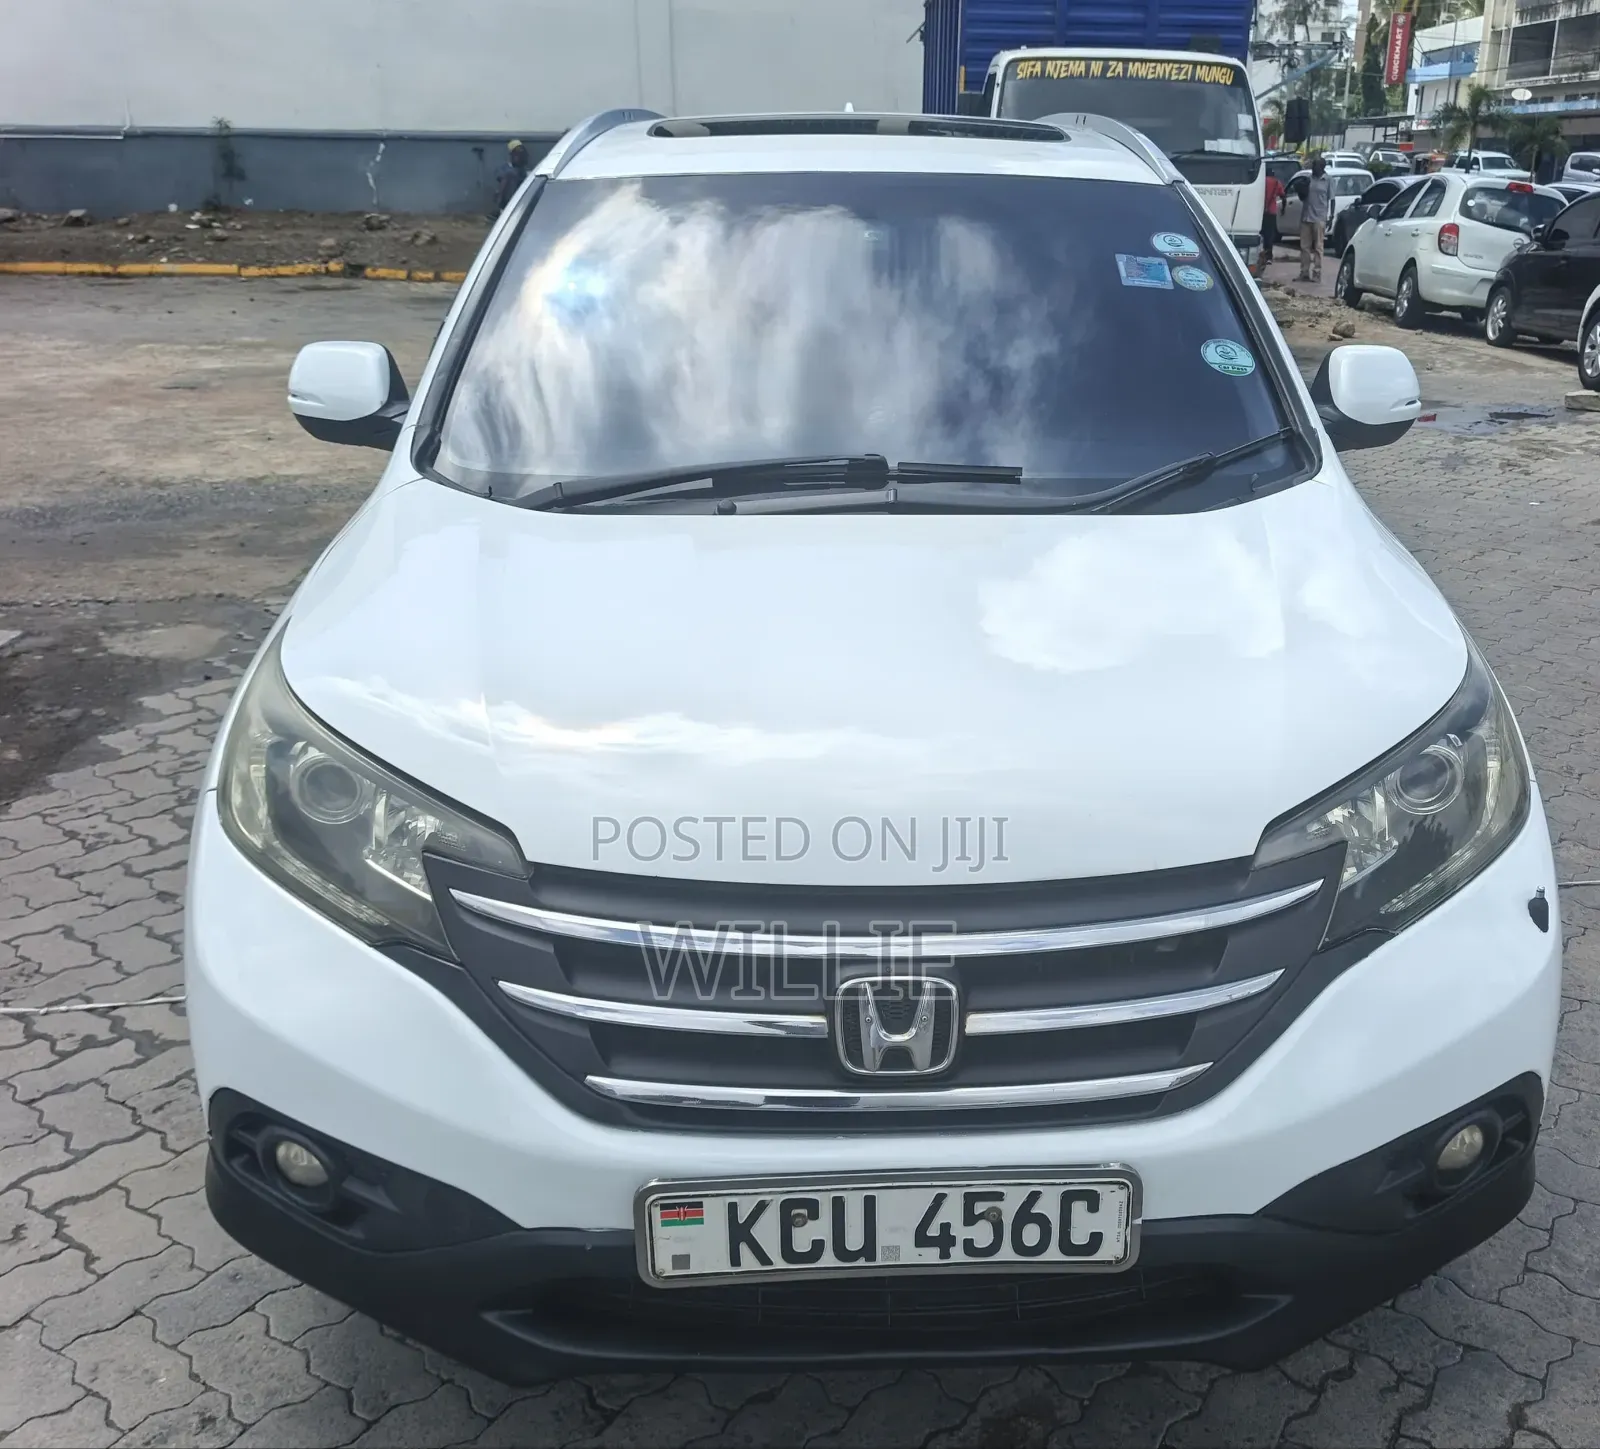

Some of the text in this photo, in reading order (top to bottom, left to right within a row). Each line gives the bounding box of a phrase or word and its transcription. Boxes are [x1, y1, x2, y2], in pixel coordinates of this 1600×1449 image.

[1016, 60, 1234, 86] SIFA NJEMA NI ZA MWENYEZI MUNGU
[1391, 28, 1403, 80] QUICKMART
[728, 1188, 1104, 1268] KCU 456C
